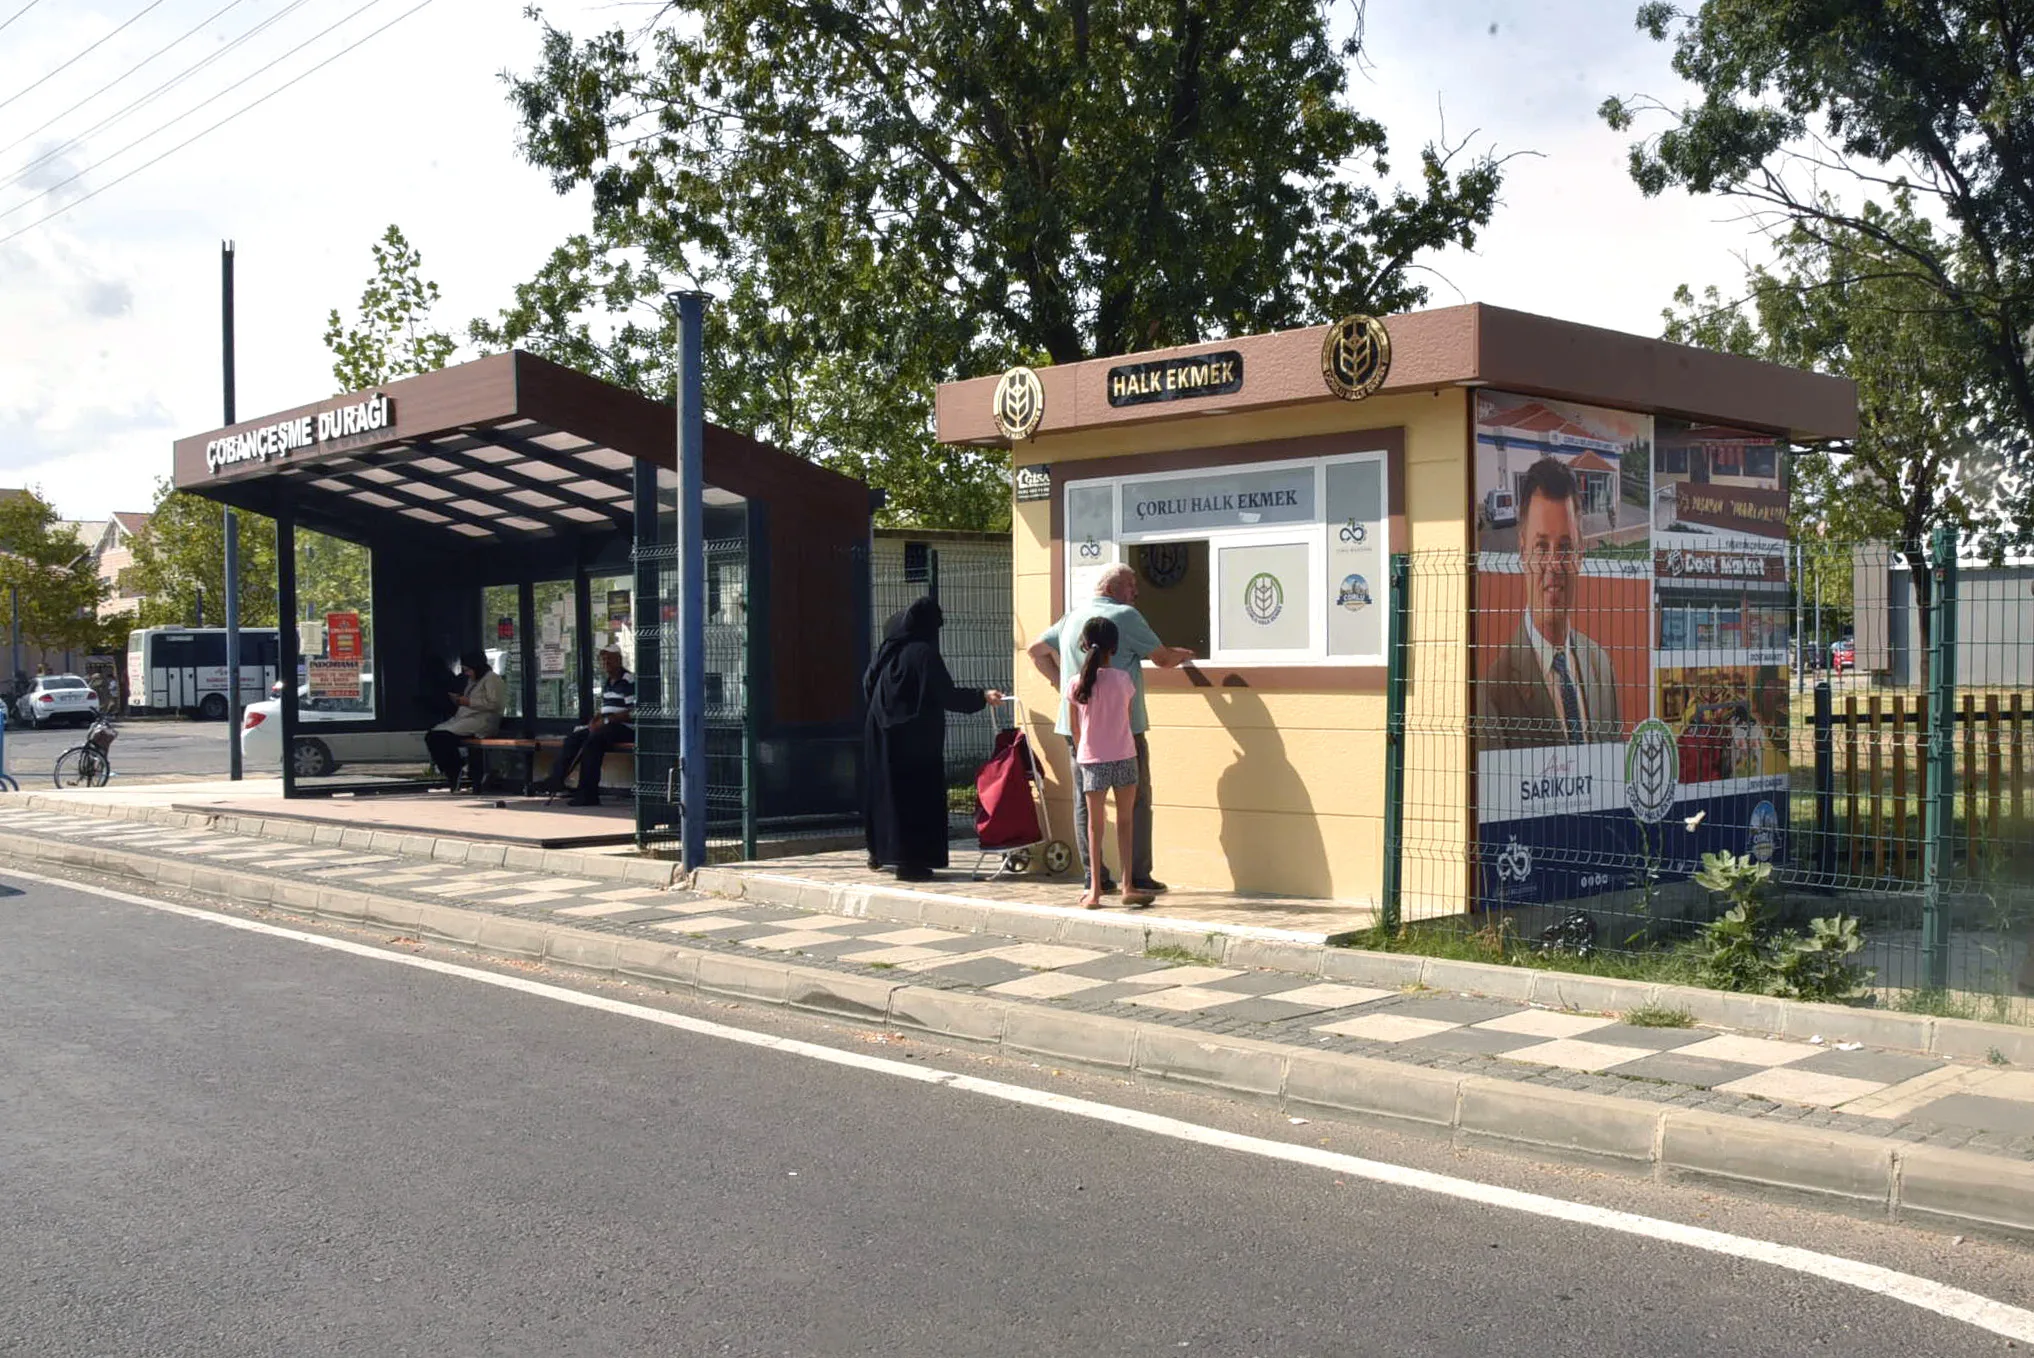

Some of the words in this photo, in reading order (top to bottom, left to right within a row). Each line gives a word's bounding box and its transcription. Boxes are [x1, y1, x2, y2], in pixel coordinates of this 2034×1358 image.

[1113, 370, 1162, 397] HALK
[1166, 360, 1235, 389] EKMEK
[206, 415, 312, 474] ÇOBANÇEŞME
[318, 392, 388, 442] DURAĞI
[1136, 498, 1187, 520] ÇORLU
[1191, 494, 1234, 513] HALK
[1237, 489, 1298, 509] EKMEK
[1521, 775, 1593, 801] SARIKURT
